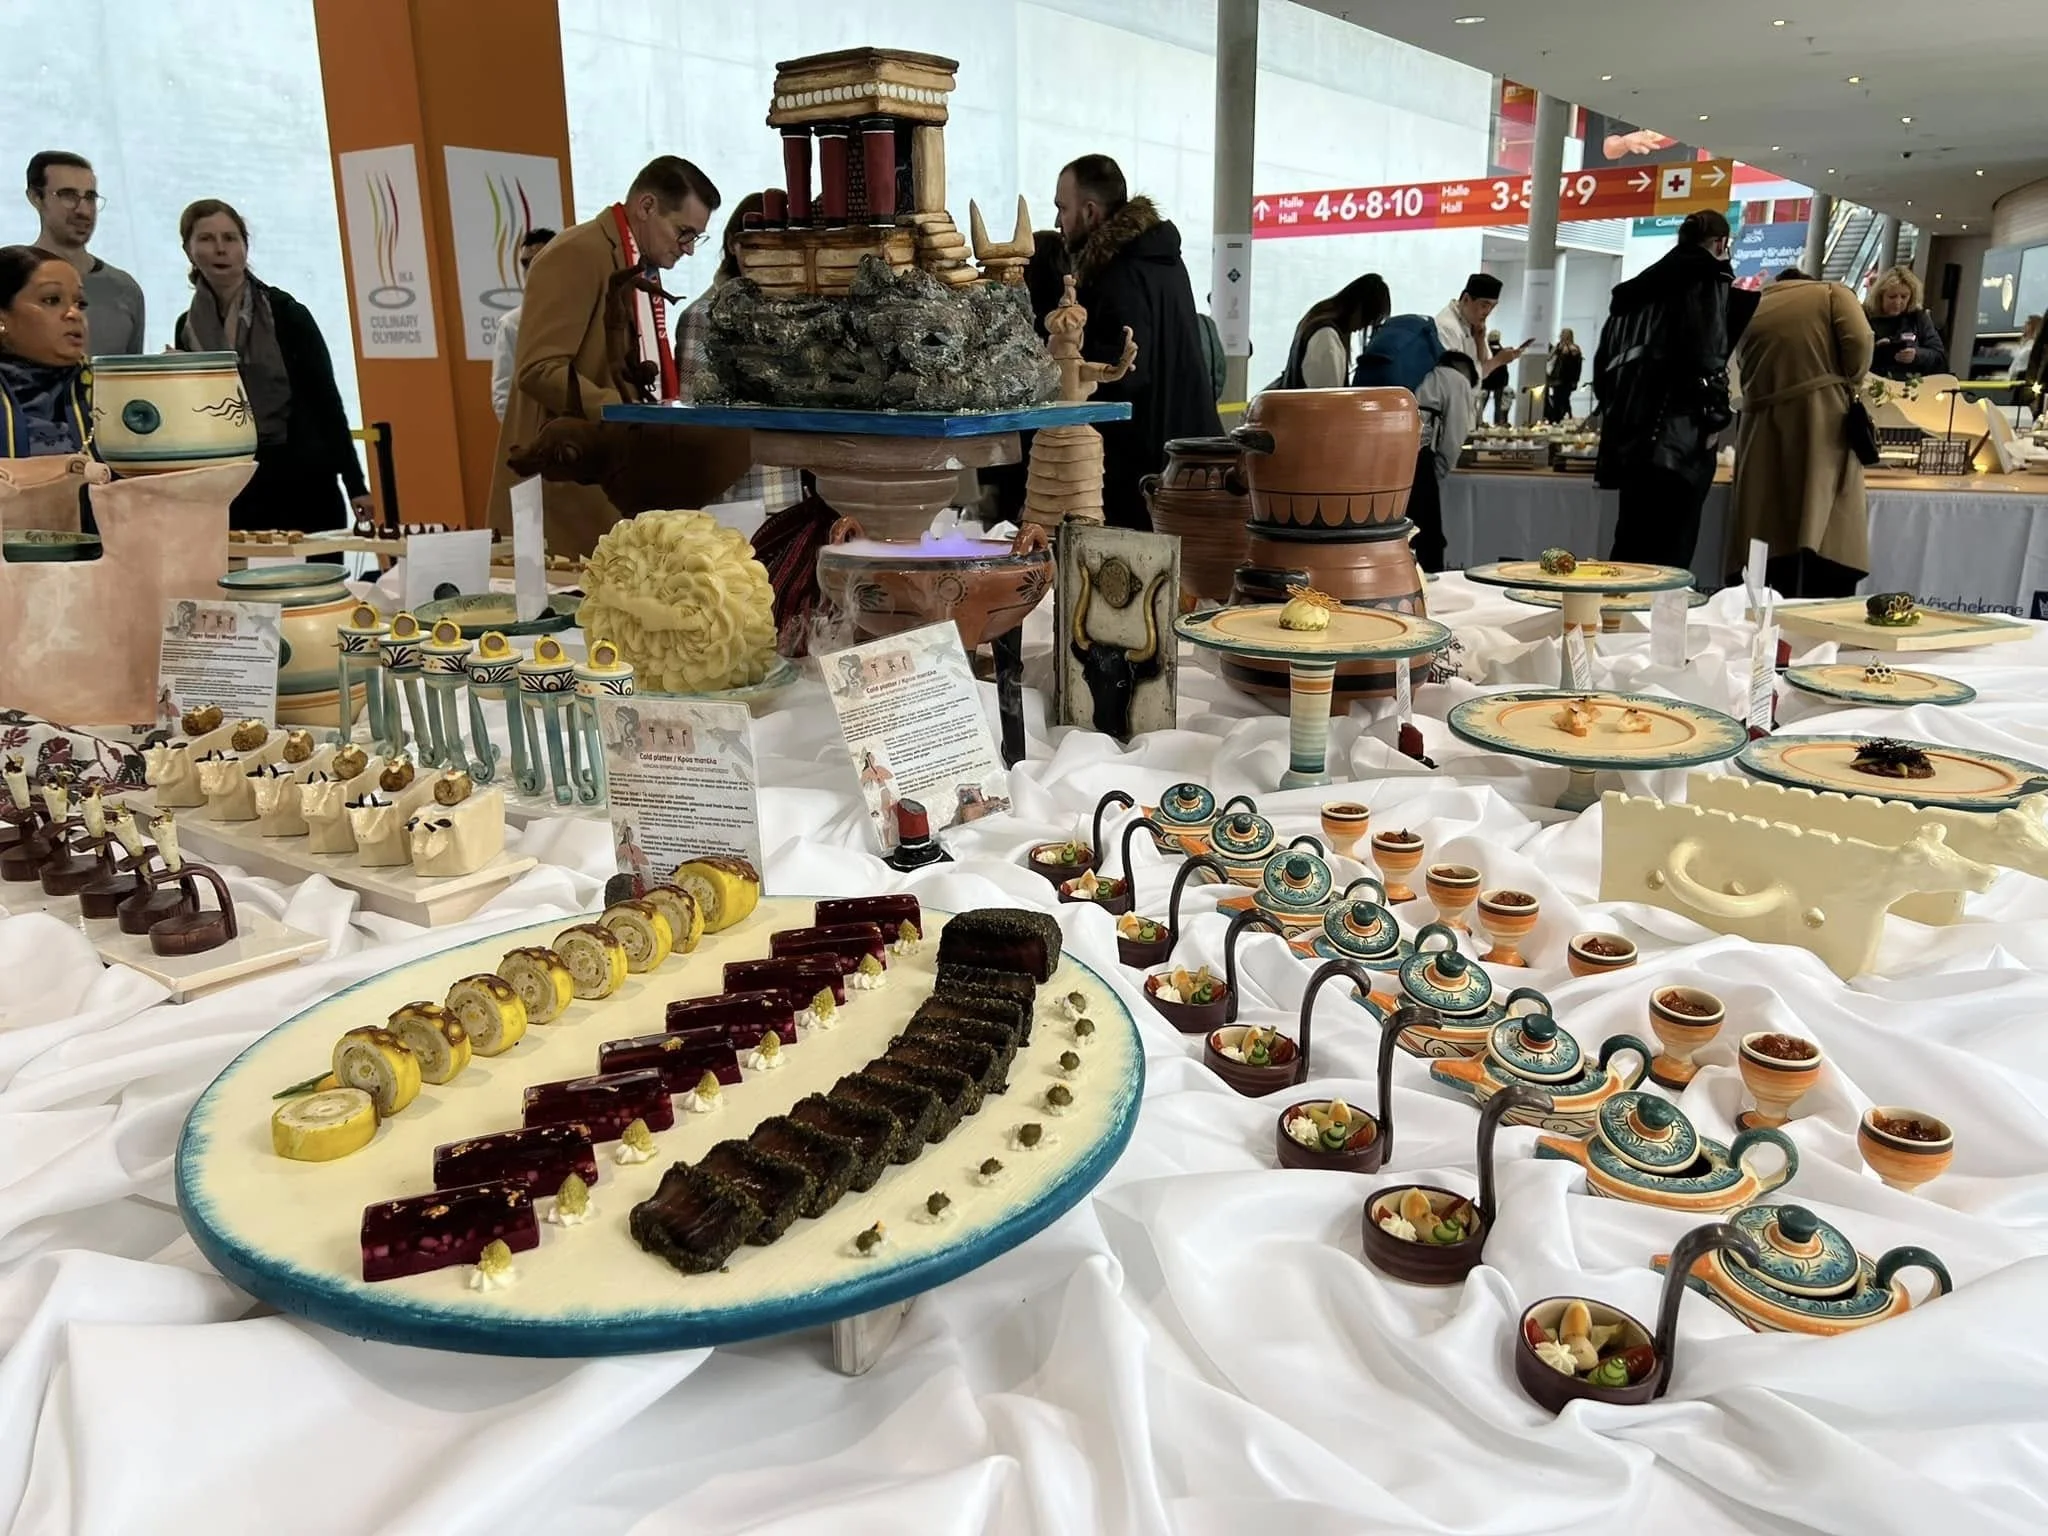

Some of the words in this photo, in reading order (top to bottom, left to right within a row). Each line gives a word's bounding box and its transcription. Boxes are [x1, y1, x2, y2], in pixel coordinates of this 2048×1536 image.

[1441, 185, 1470, 197] Halle
[1279, 196, 1304, 209] Halle
[1441, 201, 1463, 214] Hall
[1279, 213, 1298, 224] Hall
[370, 315, 419, 330] CULINARY
[372, 330, 422, 345] OLYMPICS
[639, 752, 653, 761] Cold
[653, 753, 673, 762] platter
